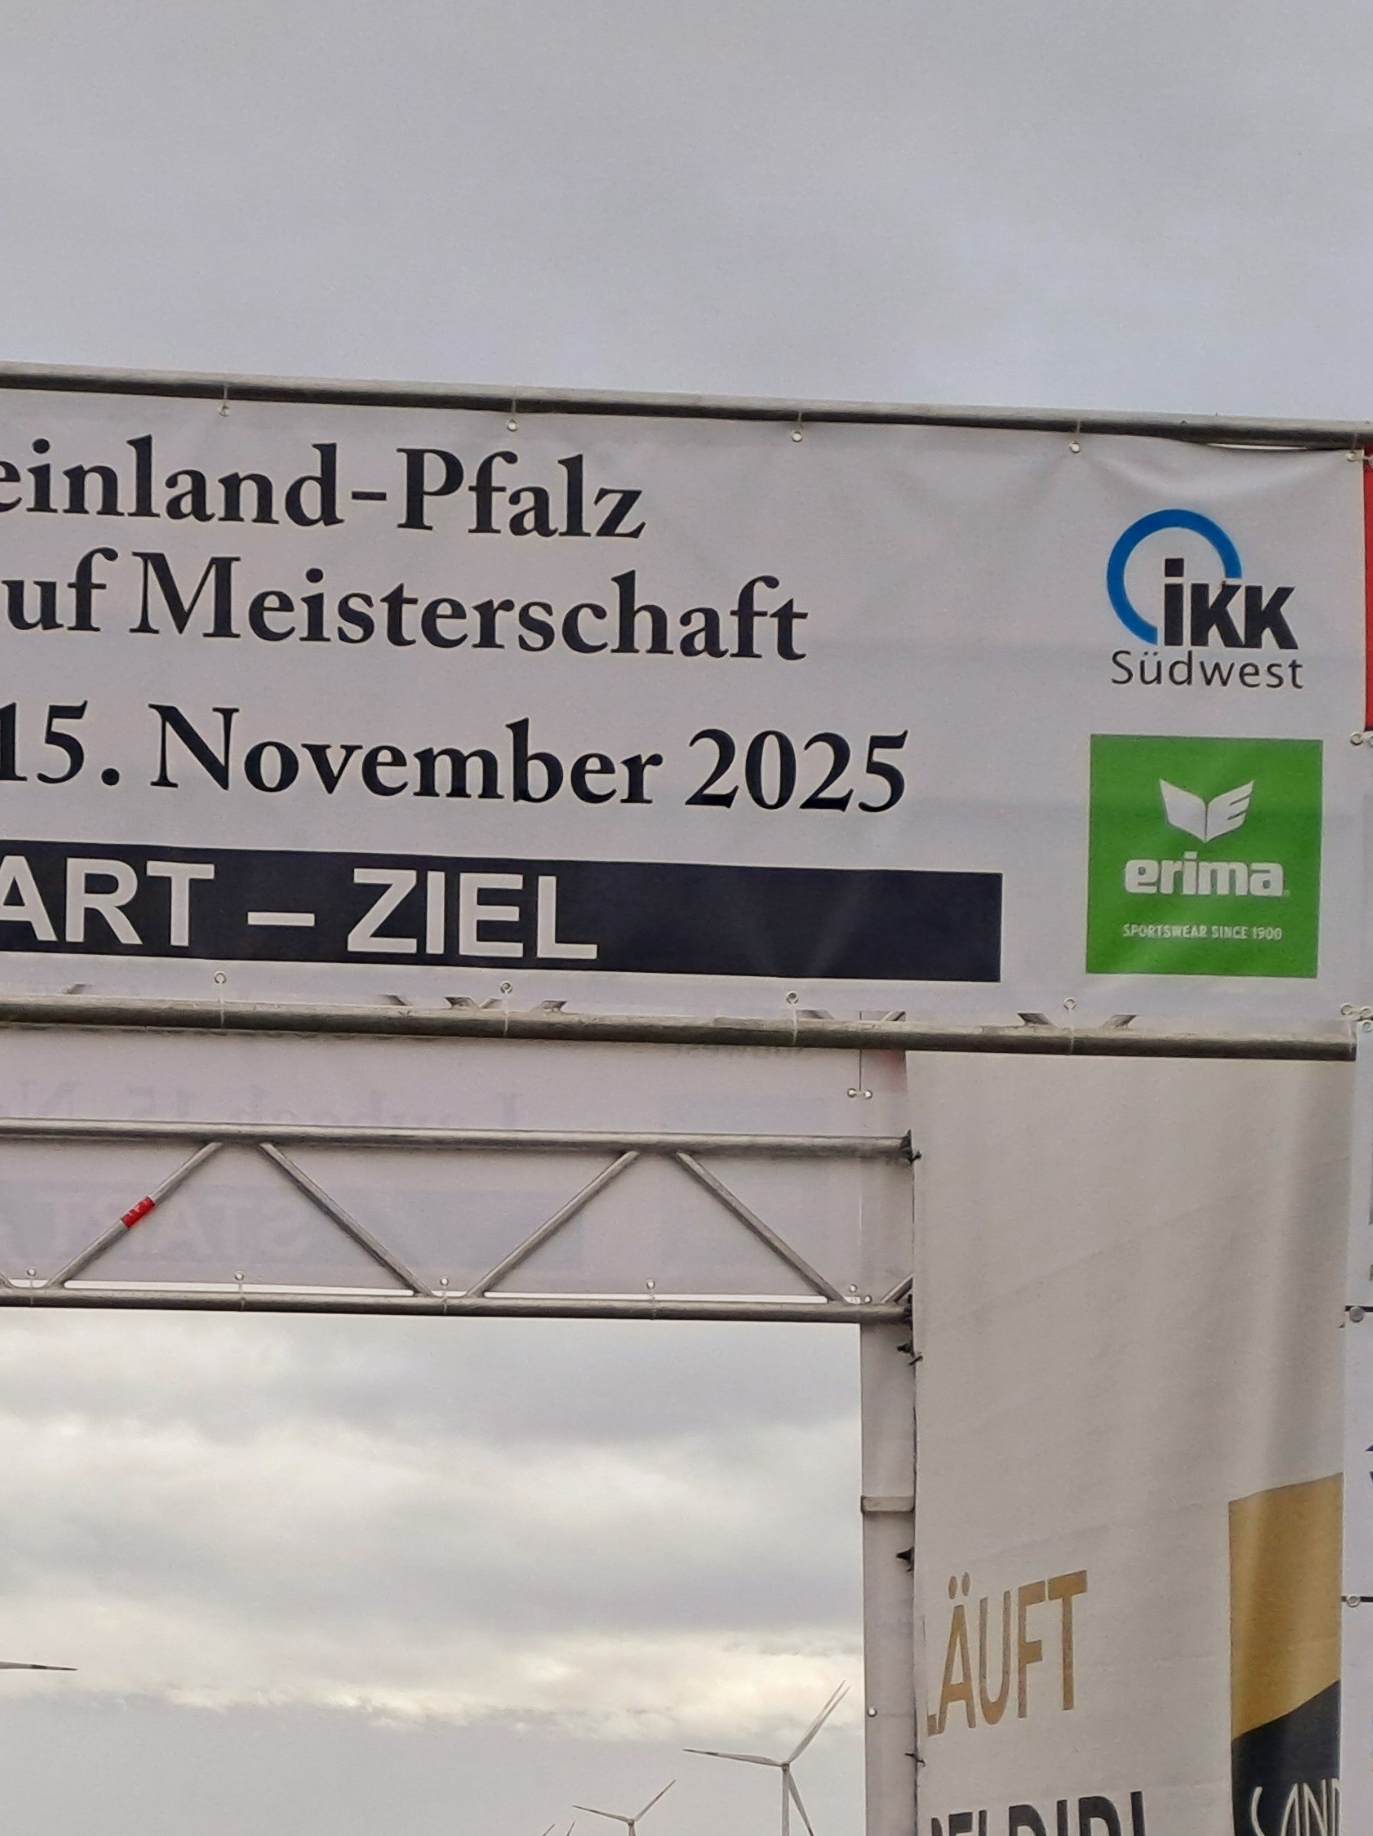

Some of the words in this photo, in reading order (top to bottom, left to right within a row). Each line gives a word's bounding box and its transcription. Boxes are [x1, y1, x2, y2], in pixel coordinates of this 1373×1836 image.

[129, 551, 810, 661] Meisterschaft
[1110, 650, 1304, 691] Südwest
[148, 703, 663, 805] November
[684, 728, 910, 814] 2025
[1123, 852, 1284, 898] erima
[347, 867, 597, 960] ZIEL
[1122, 924, 1208, 941] SPORTSWEAR
[1211, 926, 1249, 941] SINCE
[1252, 926, 1283, 941] 1900
